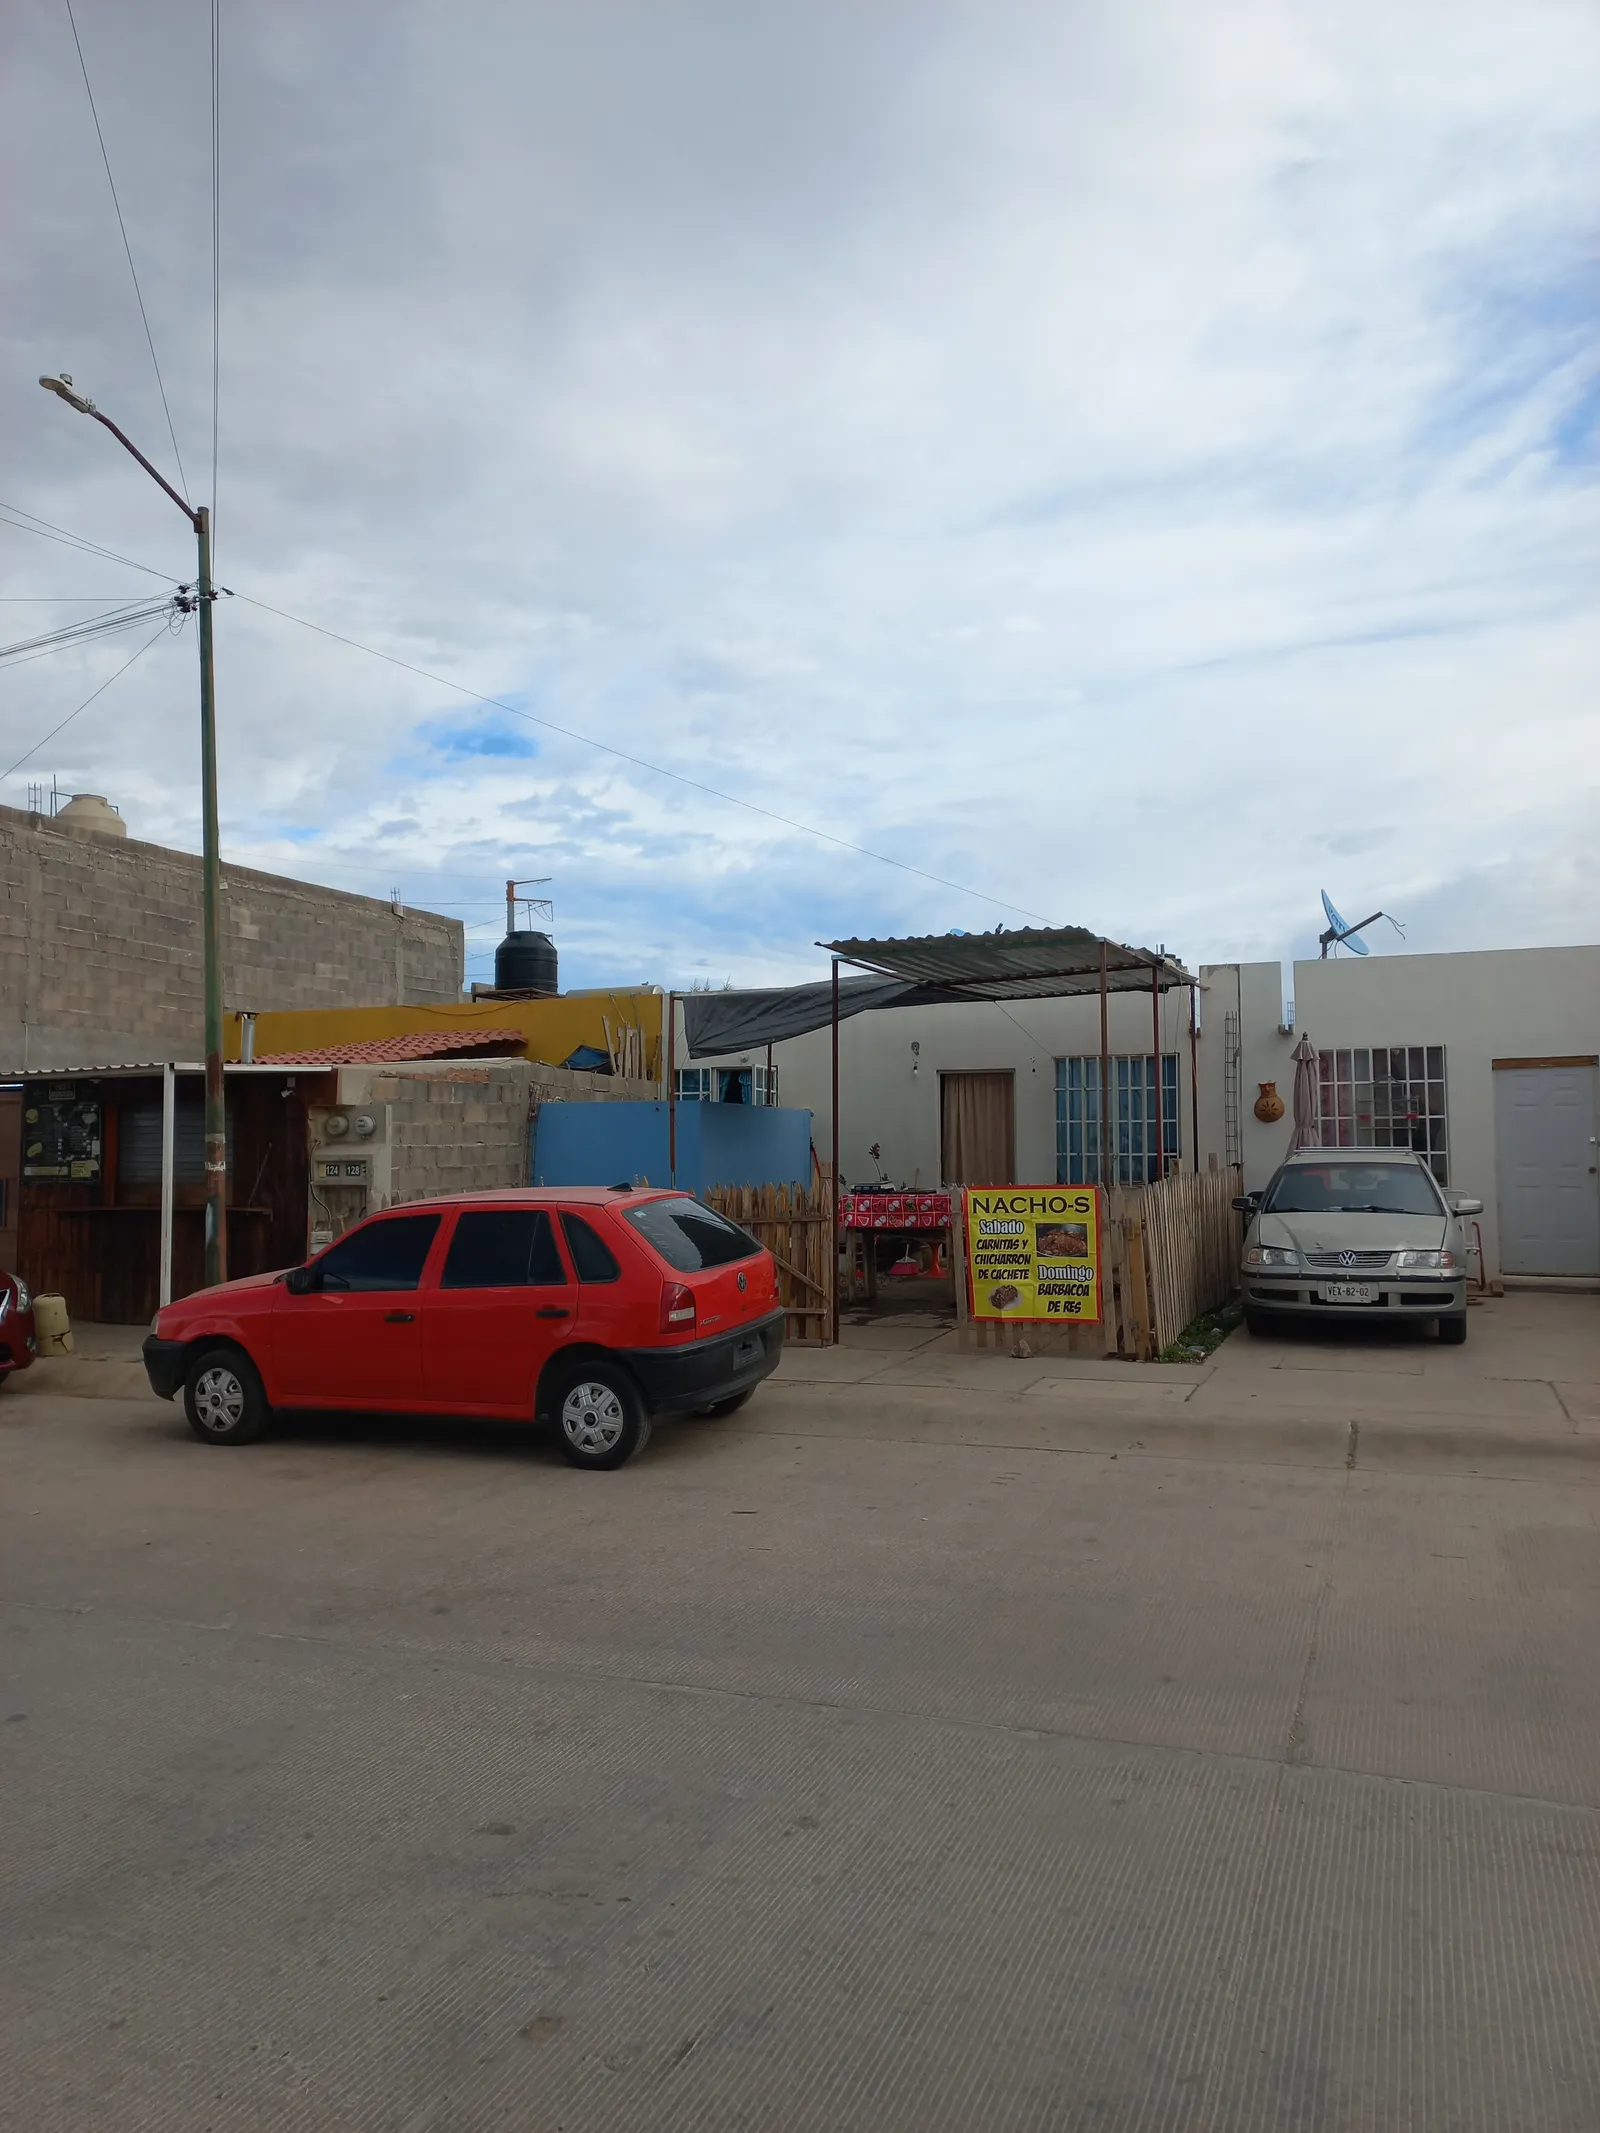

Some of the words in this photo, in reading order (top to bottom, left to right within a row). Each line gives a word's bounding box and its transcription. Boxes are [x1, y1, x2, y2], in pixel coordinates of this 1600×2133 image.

[326, 1165, 339, 1175] 124
[347, 1165, 360, 1175] 128
[972, 1196, 1091, 1214] NACHO-S
[979, 1219, 1025, 1235] Sabado
[976, 1239, 1019, 1250] CARNITAS
[1021, 1239, 1029, 1249] Y
[974, 1253, 1031, 1266] CHICHARRON
[978, 1269, 989, 1280] DE
[990, 1269, 1030, 1280] CACHETE
[1037, 1265, 1094, 1282] Domingo
[1037, 1283, 1090, 1297] BARBACOA
[1327, 1286, 1369, 1297] VEX-82-02
[1047, 1301, 1061, 1313] DE
[1062, 1301, 1082, 1314] RES
